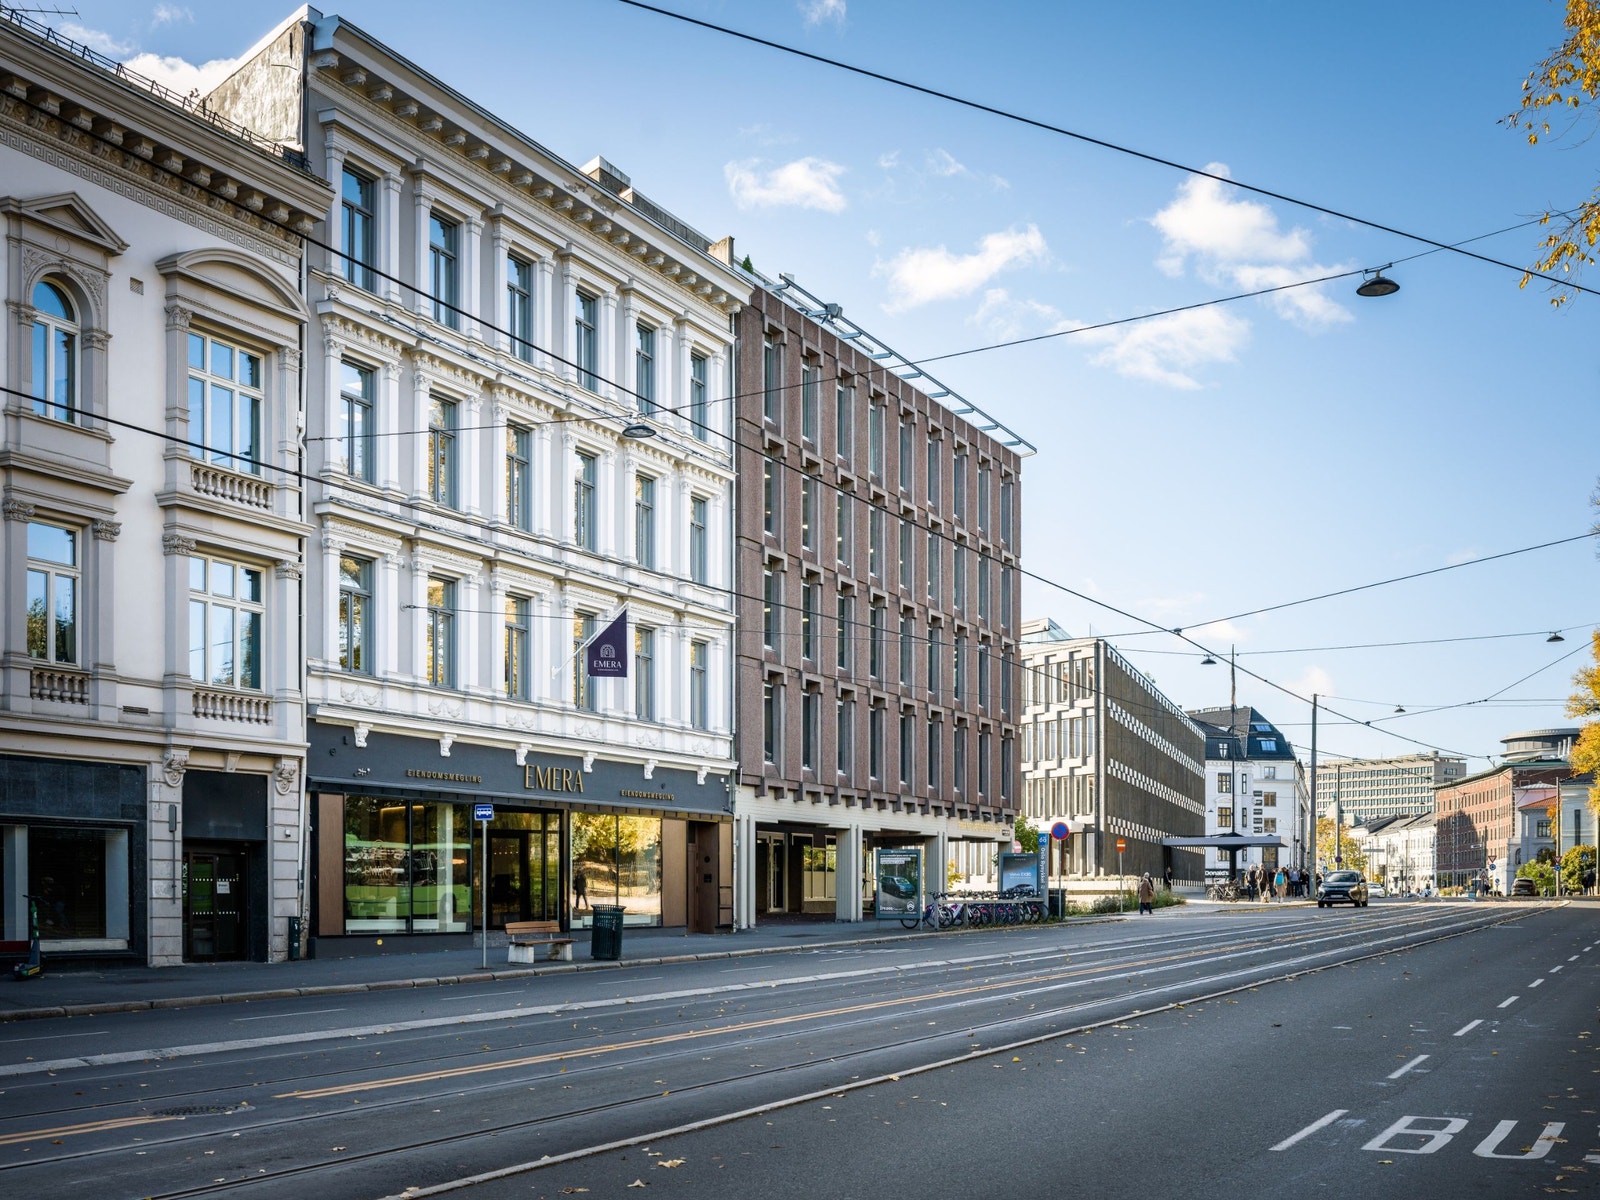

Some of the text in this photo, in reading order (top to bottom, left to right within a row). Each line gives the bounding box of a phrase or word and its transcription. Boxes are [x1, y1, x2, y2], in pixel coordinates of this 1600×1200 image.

[593, 660, 622, 669] EMERA
[407, 769, 482, 783] EIENDOMSMEGLING
[525, 764, 584, 793] EMERA
[621, 789, 675, 801] EIENDOMSMEGLING
